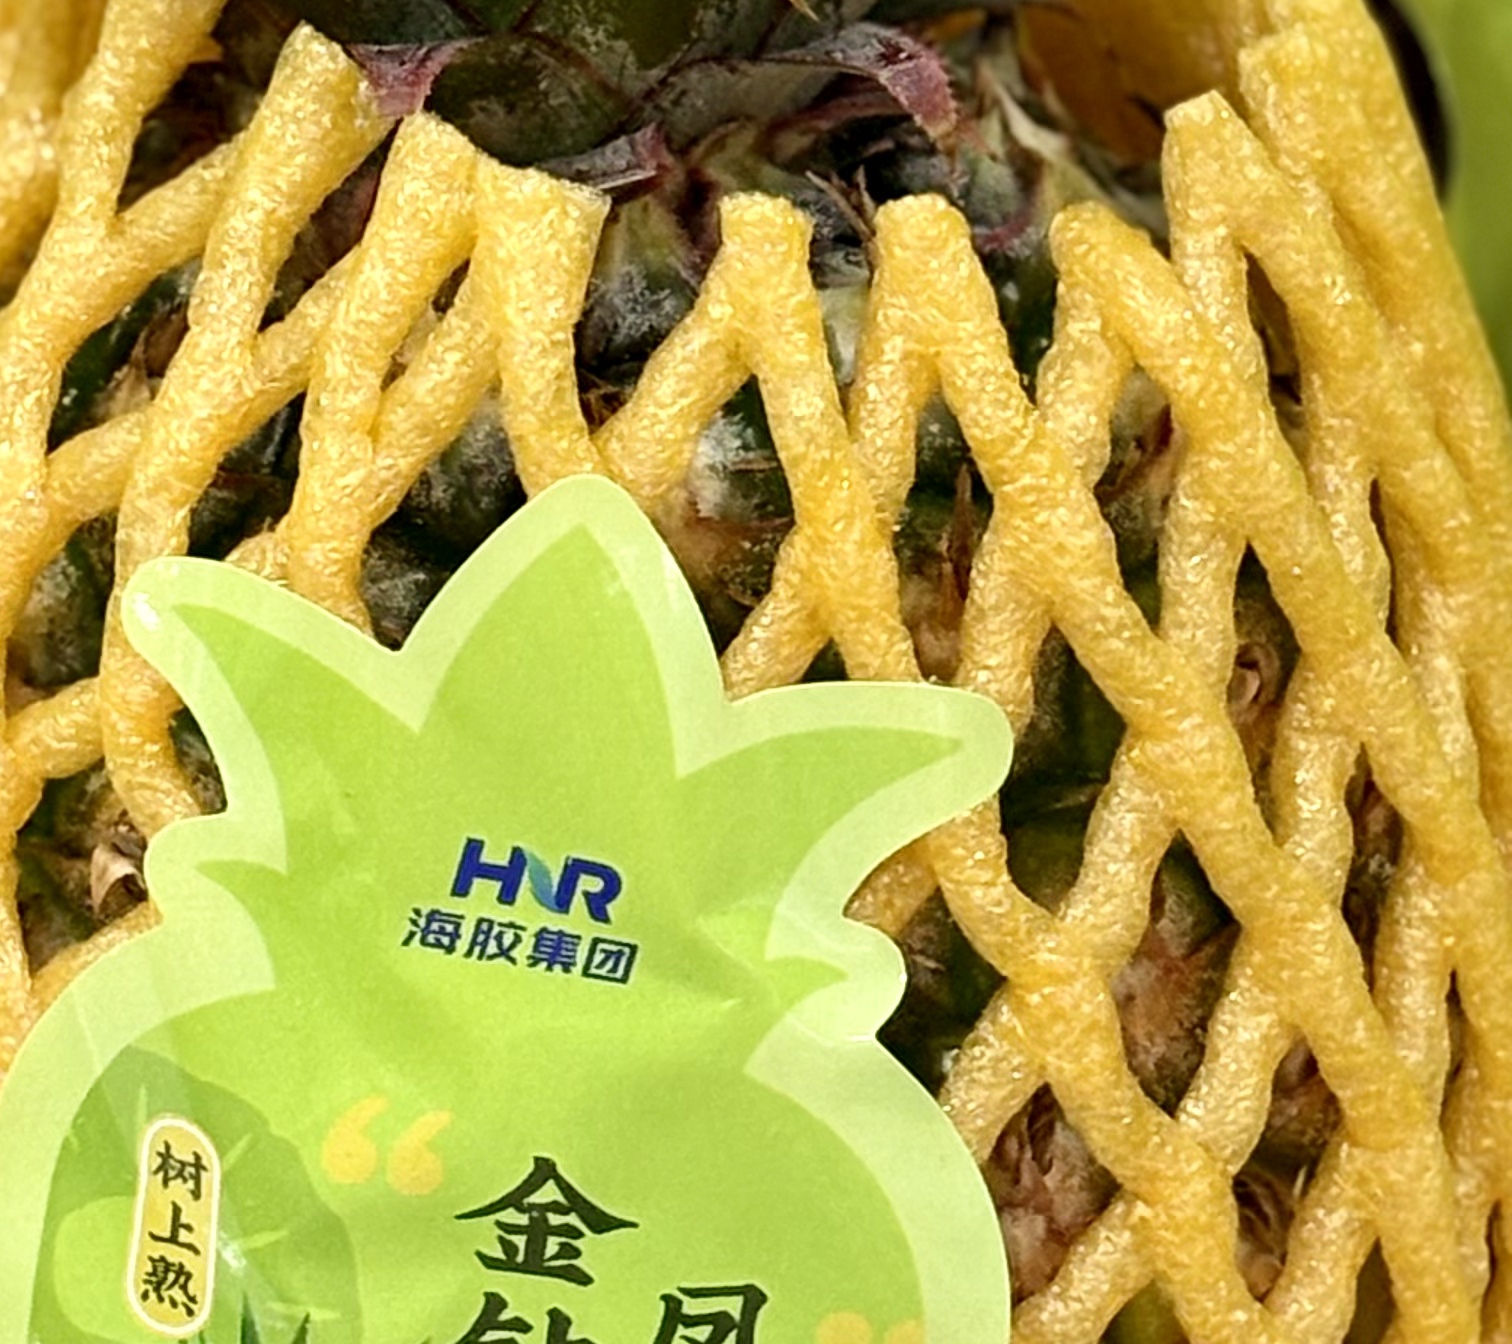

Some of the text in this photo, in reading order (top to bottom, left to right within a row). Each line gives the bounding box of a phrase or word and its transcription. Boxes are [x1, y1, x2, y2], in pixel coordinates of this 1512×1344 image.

[450, 837, 623, 924] HNR
[401, 907, 639, 984] 海胶集团
[140, 1139, 209, 1318] 树上熟
